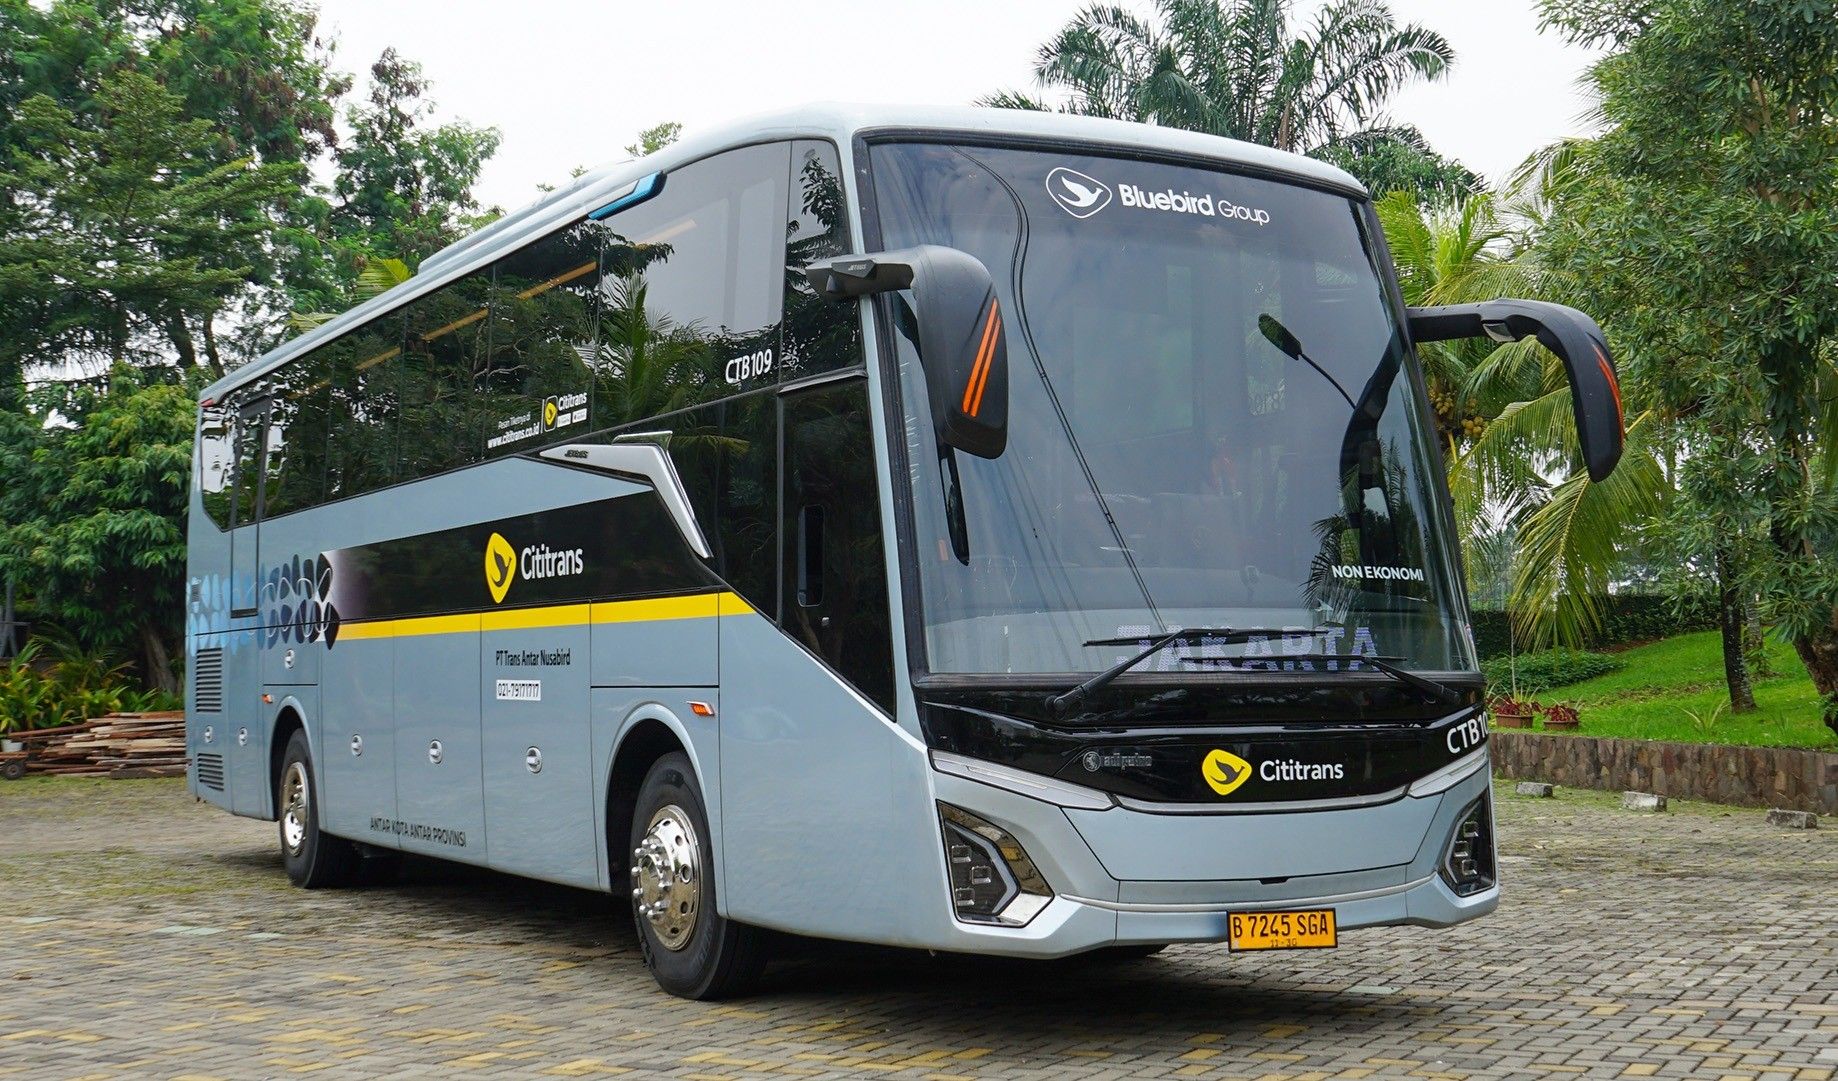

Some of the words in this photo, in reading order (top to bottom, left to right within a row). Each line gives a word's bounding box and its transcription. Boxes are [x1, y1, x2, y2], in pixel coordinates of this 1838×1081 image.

[1118, 183, 1215, 216] Bluebird
[1218, 200, 1270, 226] Group
[725, 348, 772, 384] CTB109
[559, 392, 588, 411] Cititrans
[488, 421, 540, 449] www.cititrans.co.id
[521, 543, 583, 580] Cititrans
[1331, 565, 1363, 578] NON
[1364, 566, 1424, 581] EKONOMI
[496, 650, 503, 666] PT
[504, 650, 520, 666] Trans
[521, 649, 539, 666] Antar
[540, 648, 570, 666] Nusabird
[1116, 624, 1380, 672] JAKARTA
[498, 683, 539, 697] 021-79171717
[1259, 760, 1344, 782] Cititrans
[370, 817, 390, 834] ANTAR
[391, 819, 409, 837] KOTA
[409, 823, 432, 841] ANTAR
[432, 827, 467, 847] PROVINSI
[1233, 916, 1243, 938] B
[1248, 915, 1291, 938] 7245
[1297, 914, 1329, 936] SGA
